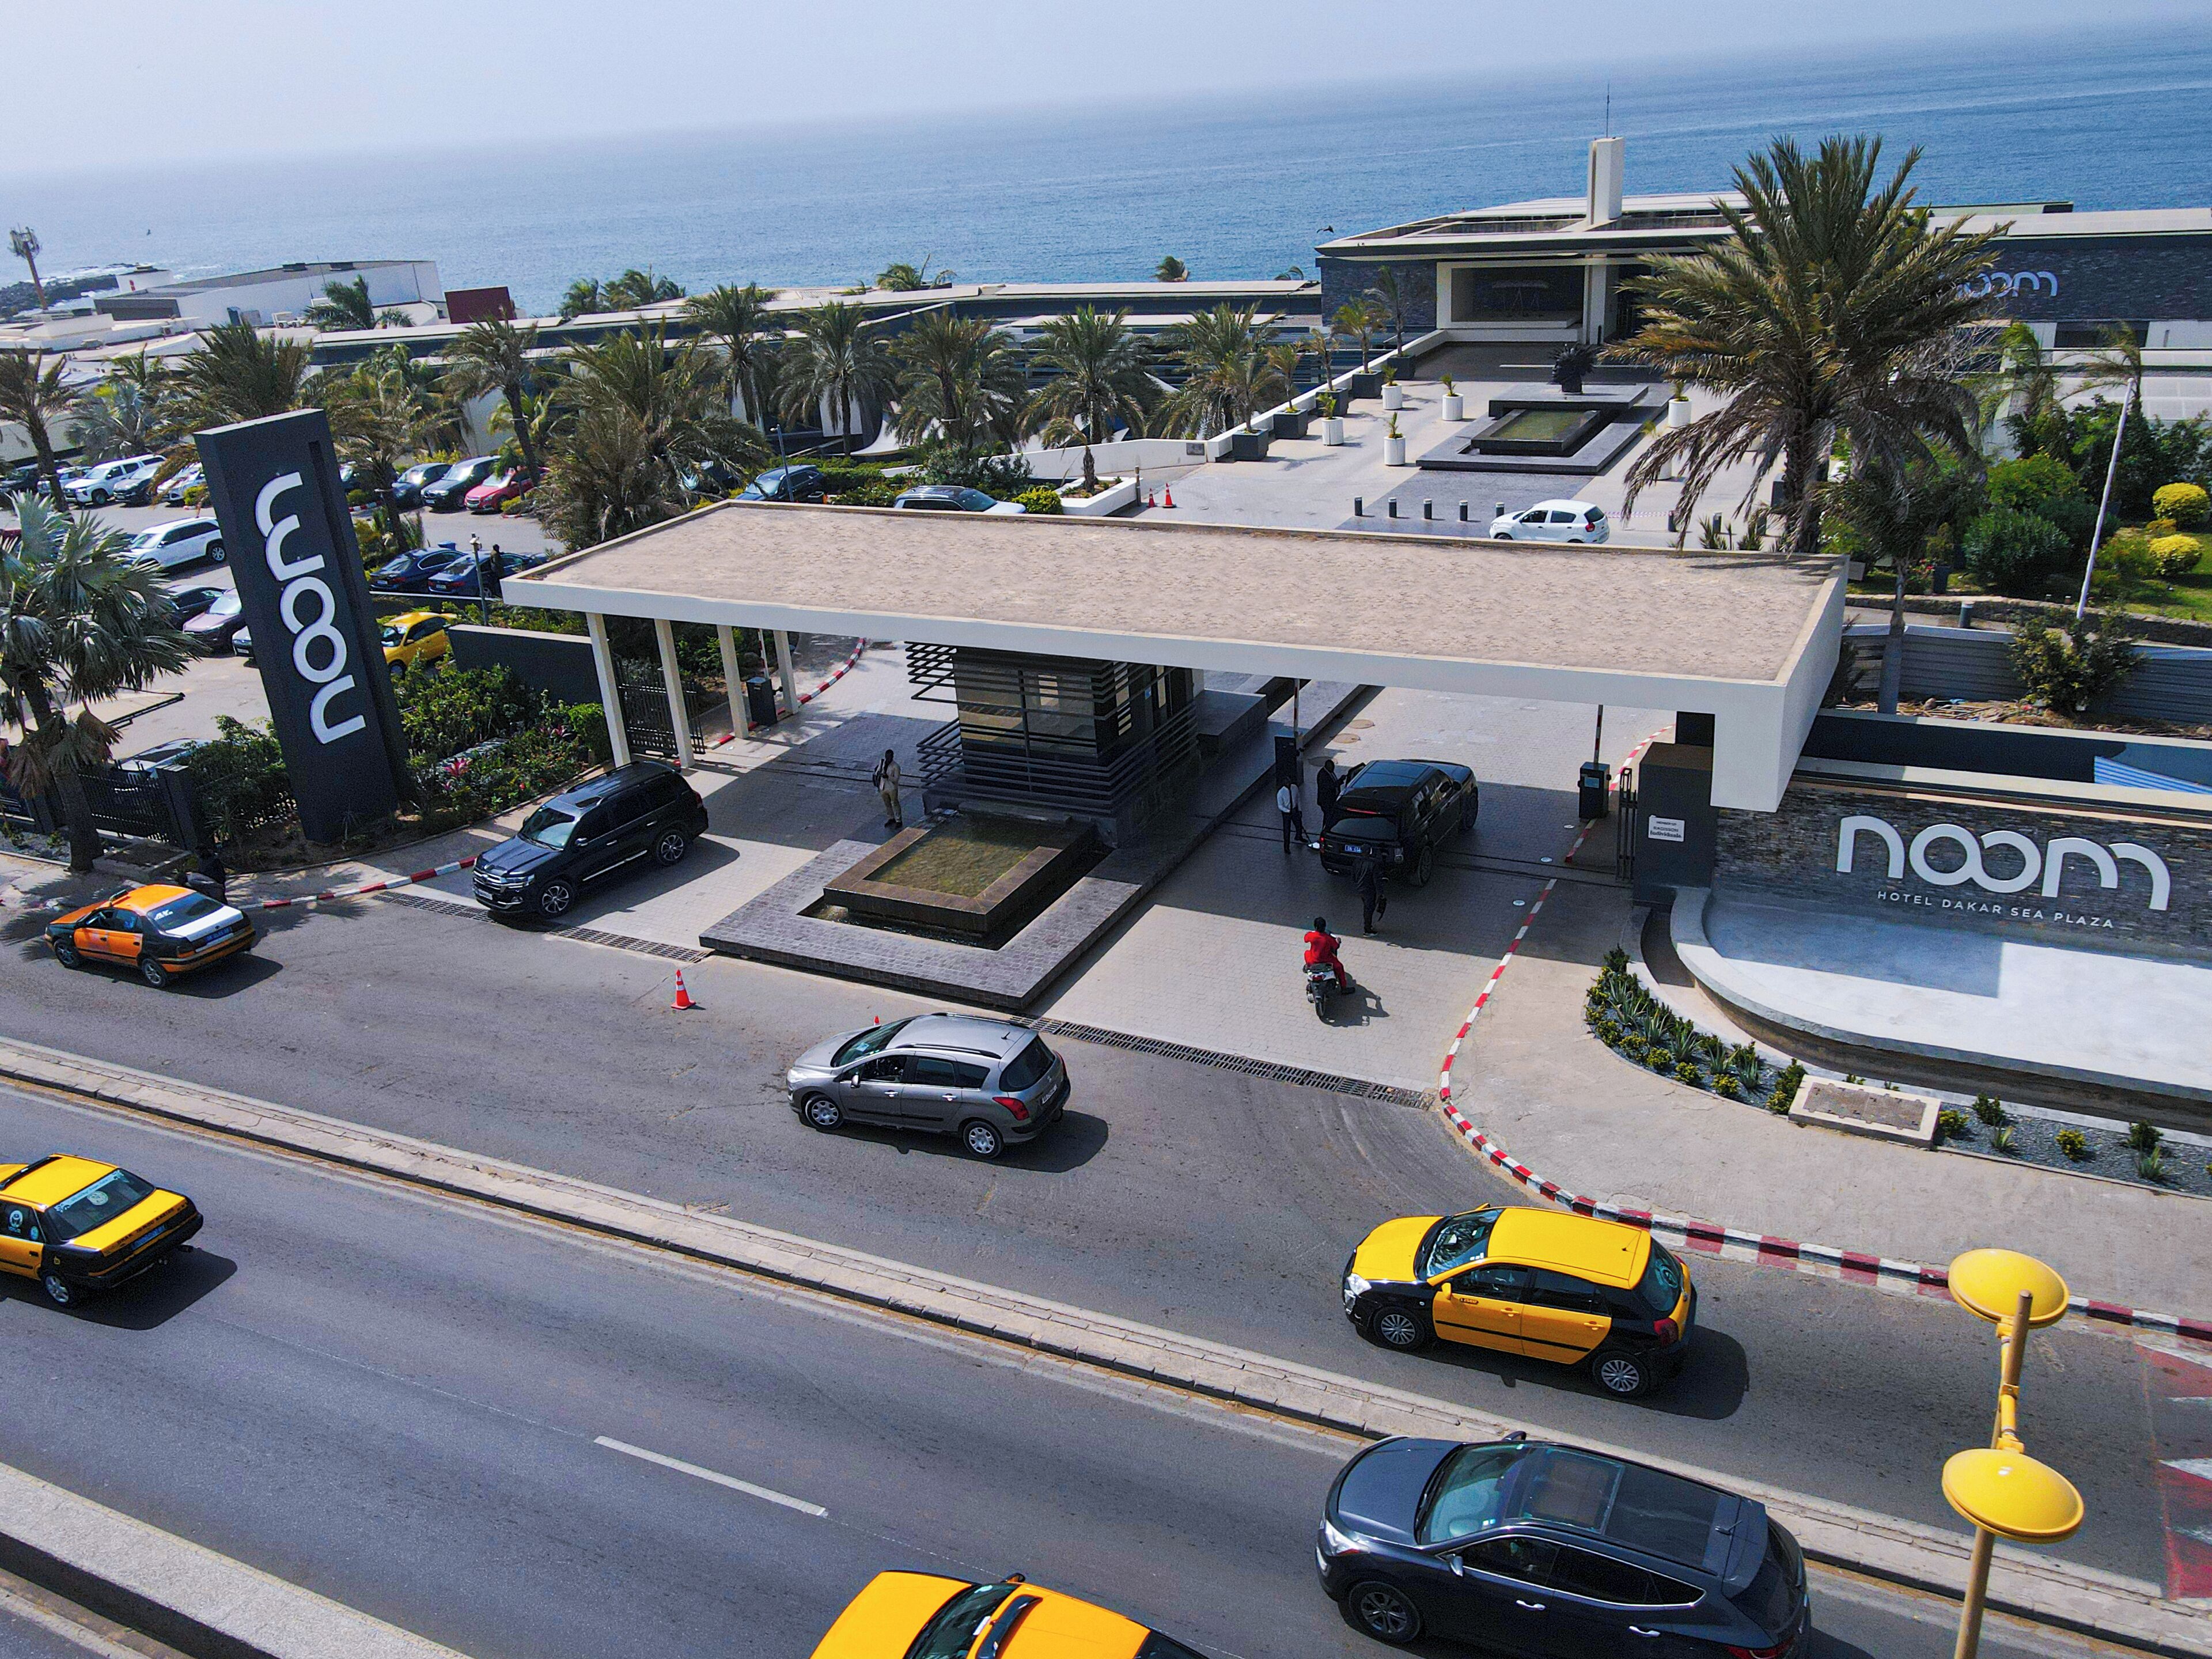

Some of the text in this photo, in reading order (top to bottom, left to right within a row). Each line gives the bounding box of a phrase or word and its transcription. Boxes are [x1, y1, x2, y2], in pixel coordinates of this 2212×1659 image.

[255, 471, 366, 744] noom
[1836, 815, 2171, 911] noom
[1877, 891, 2114, 929] HOTEL DAKAR SEA PLAZA
